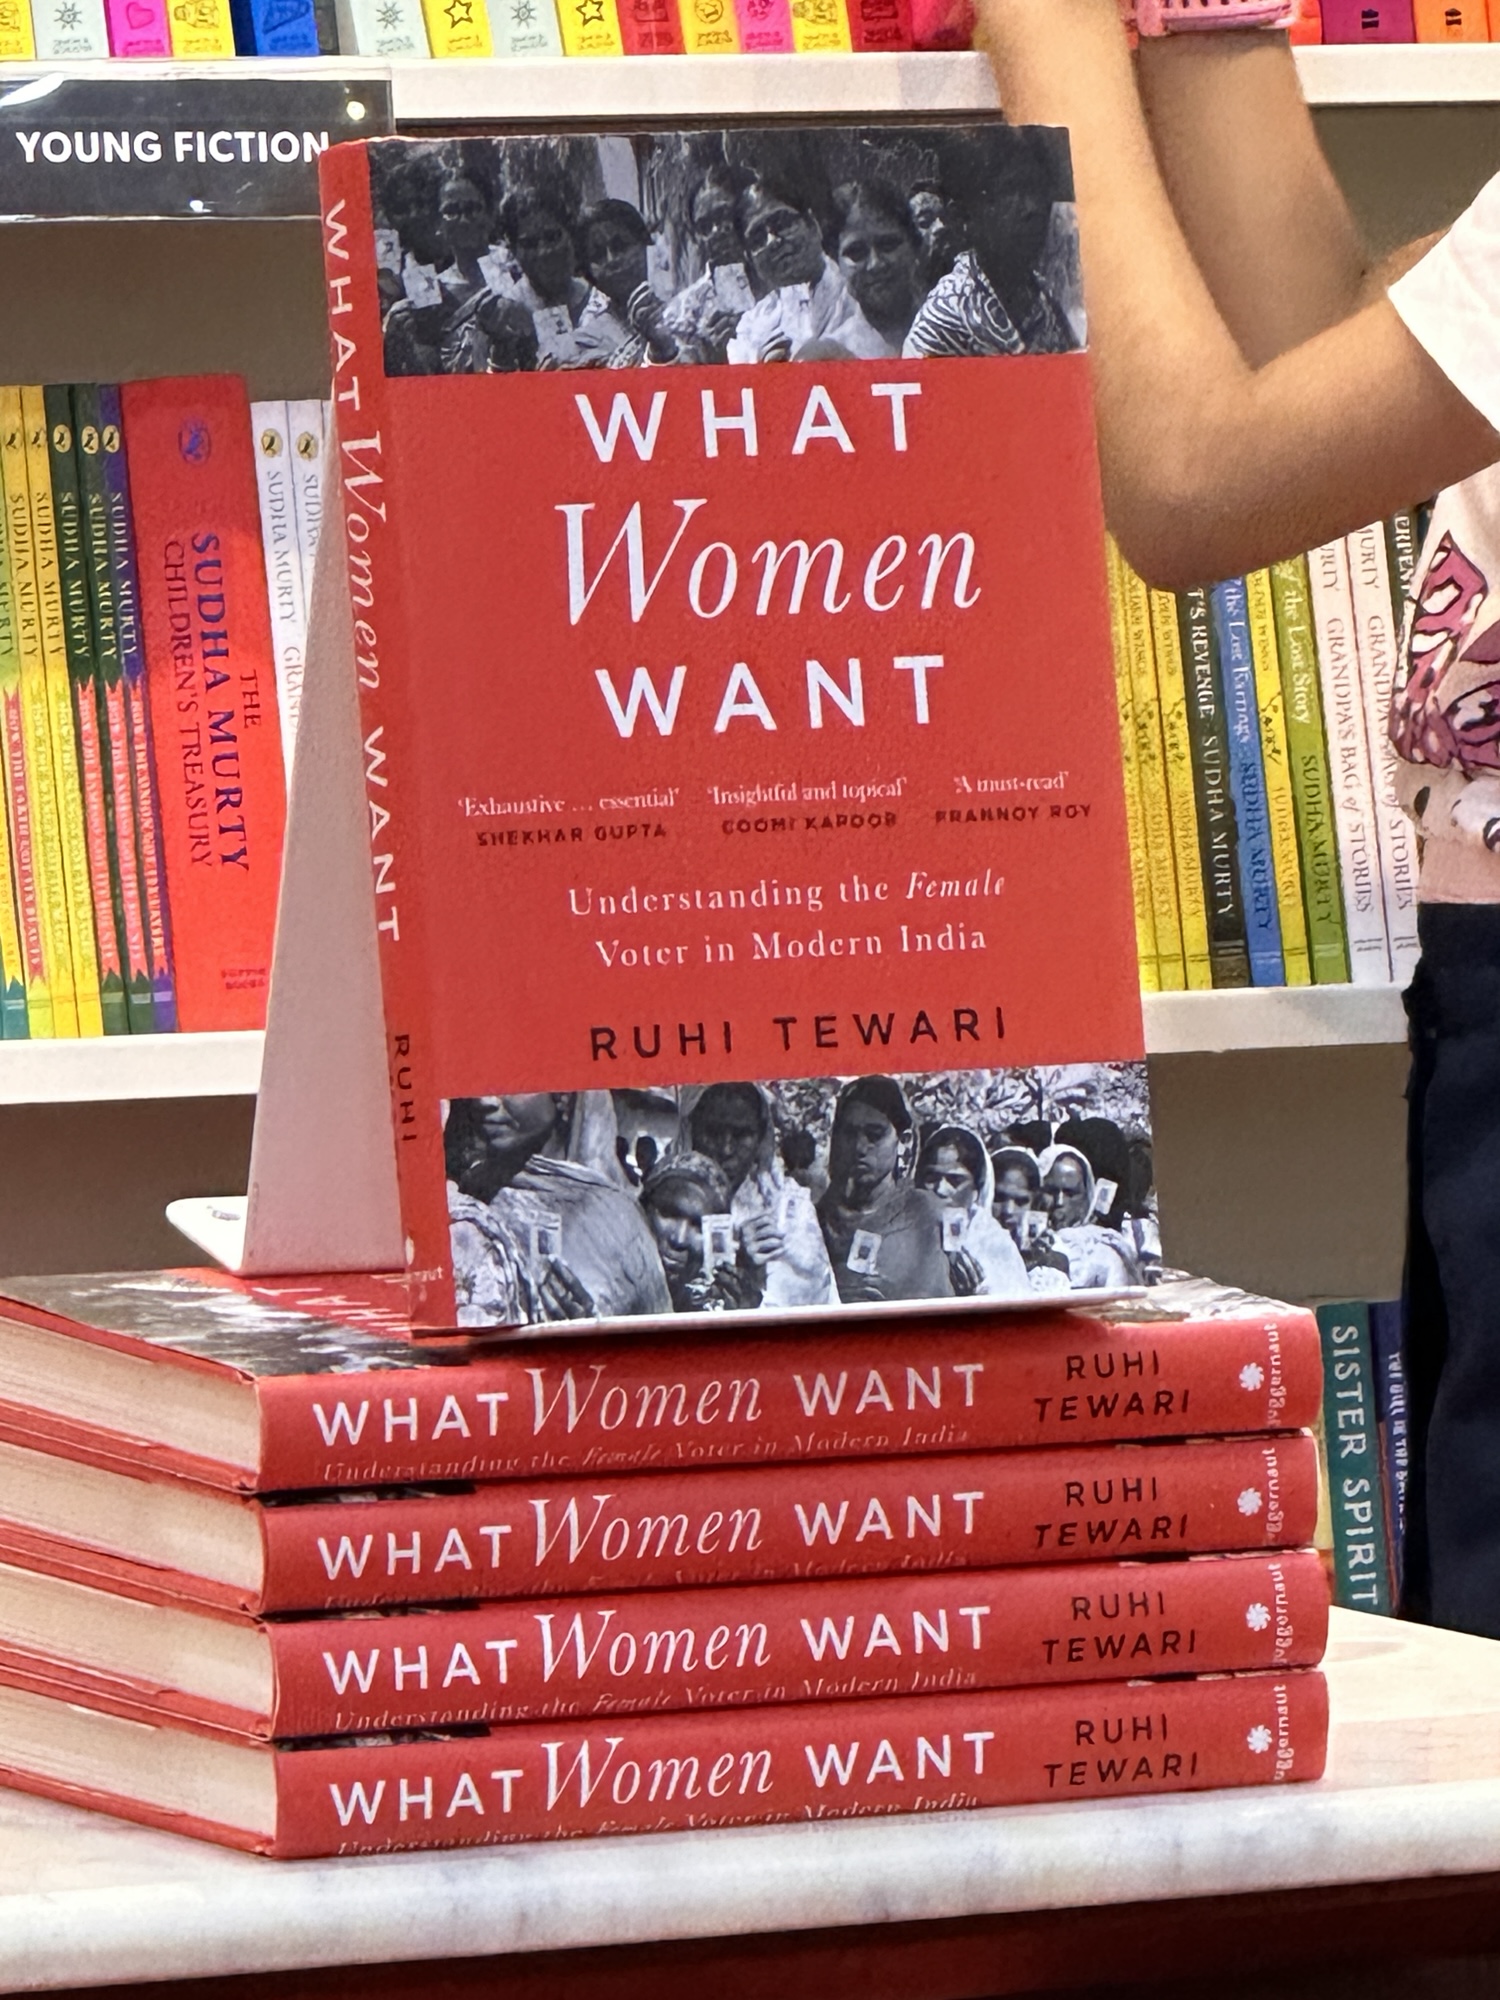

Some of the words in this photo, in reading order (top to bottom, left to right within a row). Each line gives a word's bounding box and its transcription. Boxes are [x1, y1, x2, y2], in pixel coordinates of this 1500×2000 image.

[16, 132, 161, 163] YOUNG
[175, 131, 329, 162] FICTION
[325, 199, 360, 411] WHAT
[574, 382, 922, 463] WHAT
[10, 493, 29, 571] SUDHA
[36, 492, 54, 569] SUDHA
[60, 492, 80, 571] SUDHA
[88, 493, 109, 572] SUDHA
[109, 492, 130, 570] SUDHA
[266, 470, 288, 545] SUDHA
[273, 548, 297, 624] MURTY
[342, 430, 386, 689] Women
[554, 498, 982, 626] Women
[18, 580, 38, 657] MURTY
[43, 580, 64, 655] MURTY
[68, 580, 90, 658] MURTY
[97, 581, 117, 659] MURTY
[117, 580, 138, 655] MURTY
[164, 540, 198, 712] CHILDREN'S
[191, 531, 231, 694] SUDHA
[1289, 626, 1308, 667] Lost
[239, 668, 262, 729] THE
[595, 655, 944, 738] WANT
[1190, 625, 1216, 719] REVENGE
[1291, 673, 1313, 725] Story
[1326, 618, 1353, 745] GRANDPA'S
[179, 723, 213, 868] TREASURY
[207, 709, 249, 871] MURTY
[802, 780, 836, 800] and
[1202, 735, 1225, 822] SUDHA
[1240, 762, 1264, 842] SUDHA
[1300, 755, 1324, 834] SUDHA
[1339, 747, 1359, 787] BAG
[1342, 795, 1361, 812] of
[364, 725, 400, 941] WANT
[475, 826, 583, 847] SHEKHAR
[594, 822, 667, 841] GUPTA
[805, 811, 898, 831] KAPOOR
[935, 805, 1039, 824] PRANNOY
[1049, 803, 1092, 819] ROY
[568, 878, 824, 917] Understanding
[839, 875, 889, 902] the
[905, 867, 1006, 900] Female
[1212, 832, 1234, 915] MURTY
[1350, 823, 1374, 913] STORIES
[1389, 819, 1414, 911] STORIES
[595, 938, 689, 968] Voter
[704, 934, 735, 964] in
[752, 929, 883, 961] Modern
[899, 922, 987, 954] India
[590, 1020, 733, 1062] RUHI
[772, 1006, 1006, 1052] TEWARI
[394, 1034, 417, 1142] RUHI
[1066, 1350, 1160, 1381] RUHI
[1331, 1325, 1367, 1459] SISTER
[312, 1392, 510, 1447] WHAT
[525, 1364, 762, 1436] Women
[793, 1363, 984, 1417] WANT
[1034, 1389, 1190, 1422] TEWARI
[325, 1454, 523, 1481] Understanding
[530, 1451, 571, 1469] the
[677, 1441, 743, 1459] Voter
[753, 1436, 777, 1454] in
[793, 1430, 890, 1454] Modern
[902, 1424, 968, 1447] India
[1034, 1514, 1188, 1548] TEWARI
[1065, 1477, 1157, 1507] RUHI
[317, 1525, 512, 1581] WHAT
[529, 1493, 763, 1568] Women
[795, 1491, 984, 1546] WANT
[1343, 1477, 1379, 1606] SPIRIT
[1071, 1591, 1165, 1621] RUHI
[322, 1639, 518, 1695] WHAT
[533, 1610, 771, 1683] Women
[801, 1606, 990, 1662] WANT
[1042, 1629, 1196, 1665] TEWARI
[335, 1701, 530, 1731] Understanding
[540, 1697, 577, 1717] the
[593, 1689, 672, 1713] Female
[685, 1686, 751, 1705] Voter
[758, 1683, 786, 1700] in
[802, 1675, 899, 1697] Modern
[911, 1667, 977, 1691] India
[1075, 1713, 1168, 1747] RUHI
[329, 1769, 524, 1826] WHAT
[541, 1737, 774, 1812] Women
[804, 1731, 994, 1788] WANT
[913, 1792, 979, 1811] India
[1044, 1752, 1197, 1788] TEWARI
